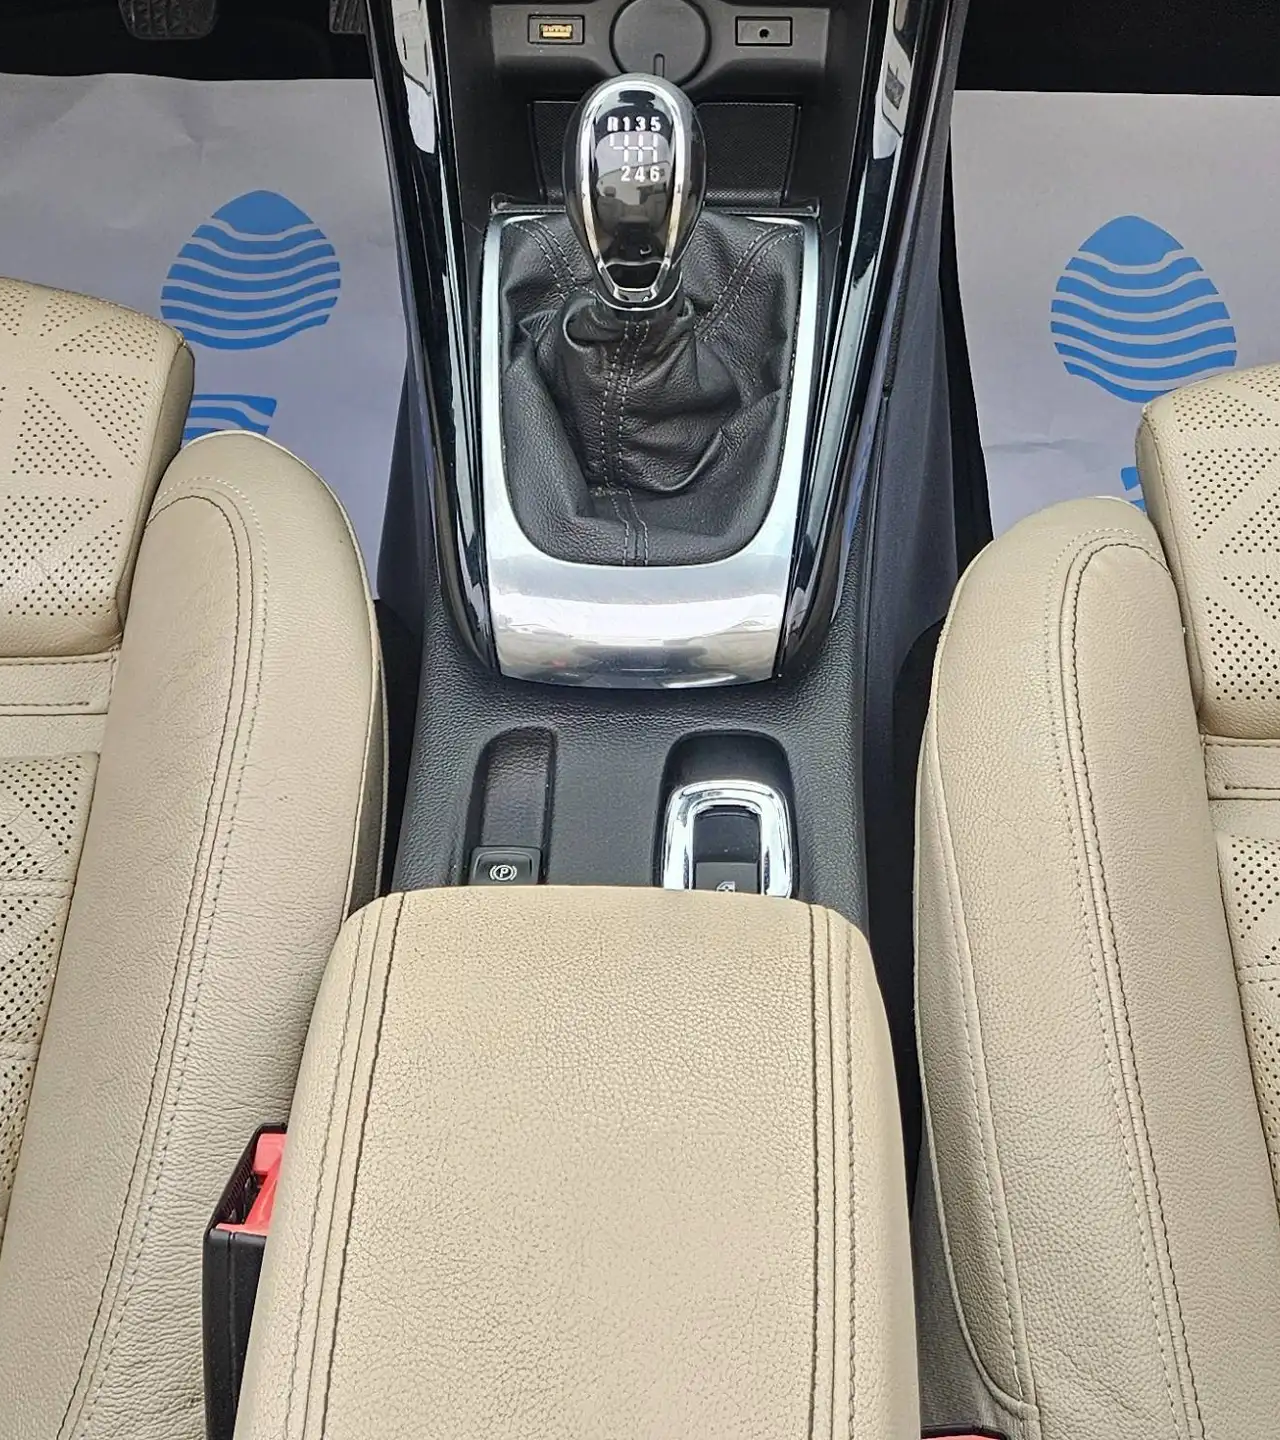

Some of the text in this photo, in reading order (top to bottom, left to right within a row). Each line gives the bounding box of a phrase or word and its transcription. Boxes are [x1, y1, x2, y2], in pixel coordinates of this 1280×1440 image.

[607, 116, 661, 132] R 1 3 5
[621, 165, 660, 182] 2 4 6
